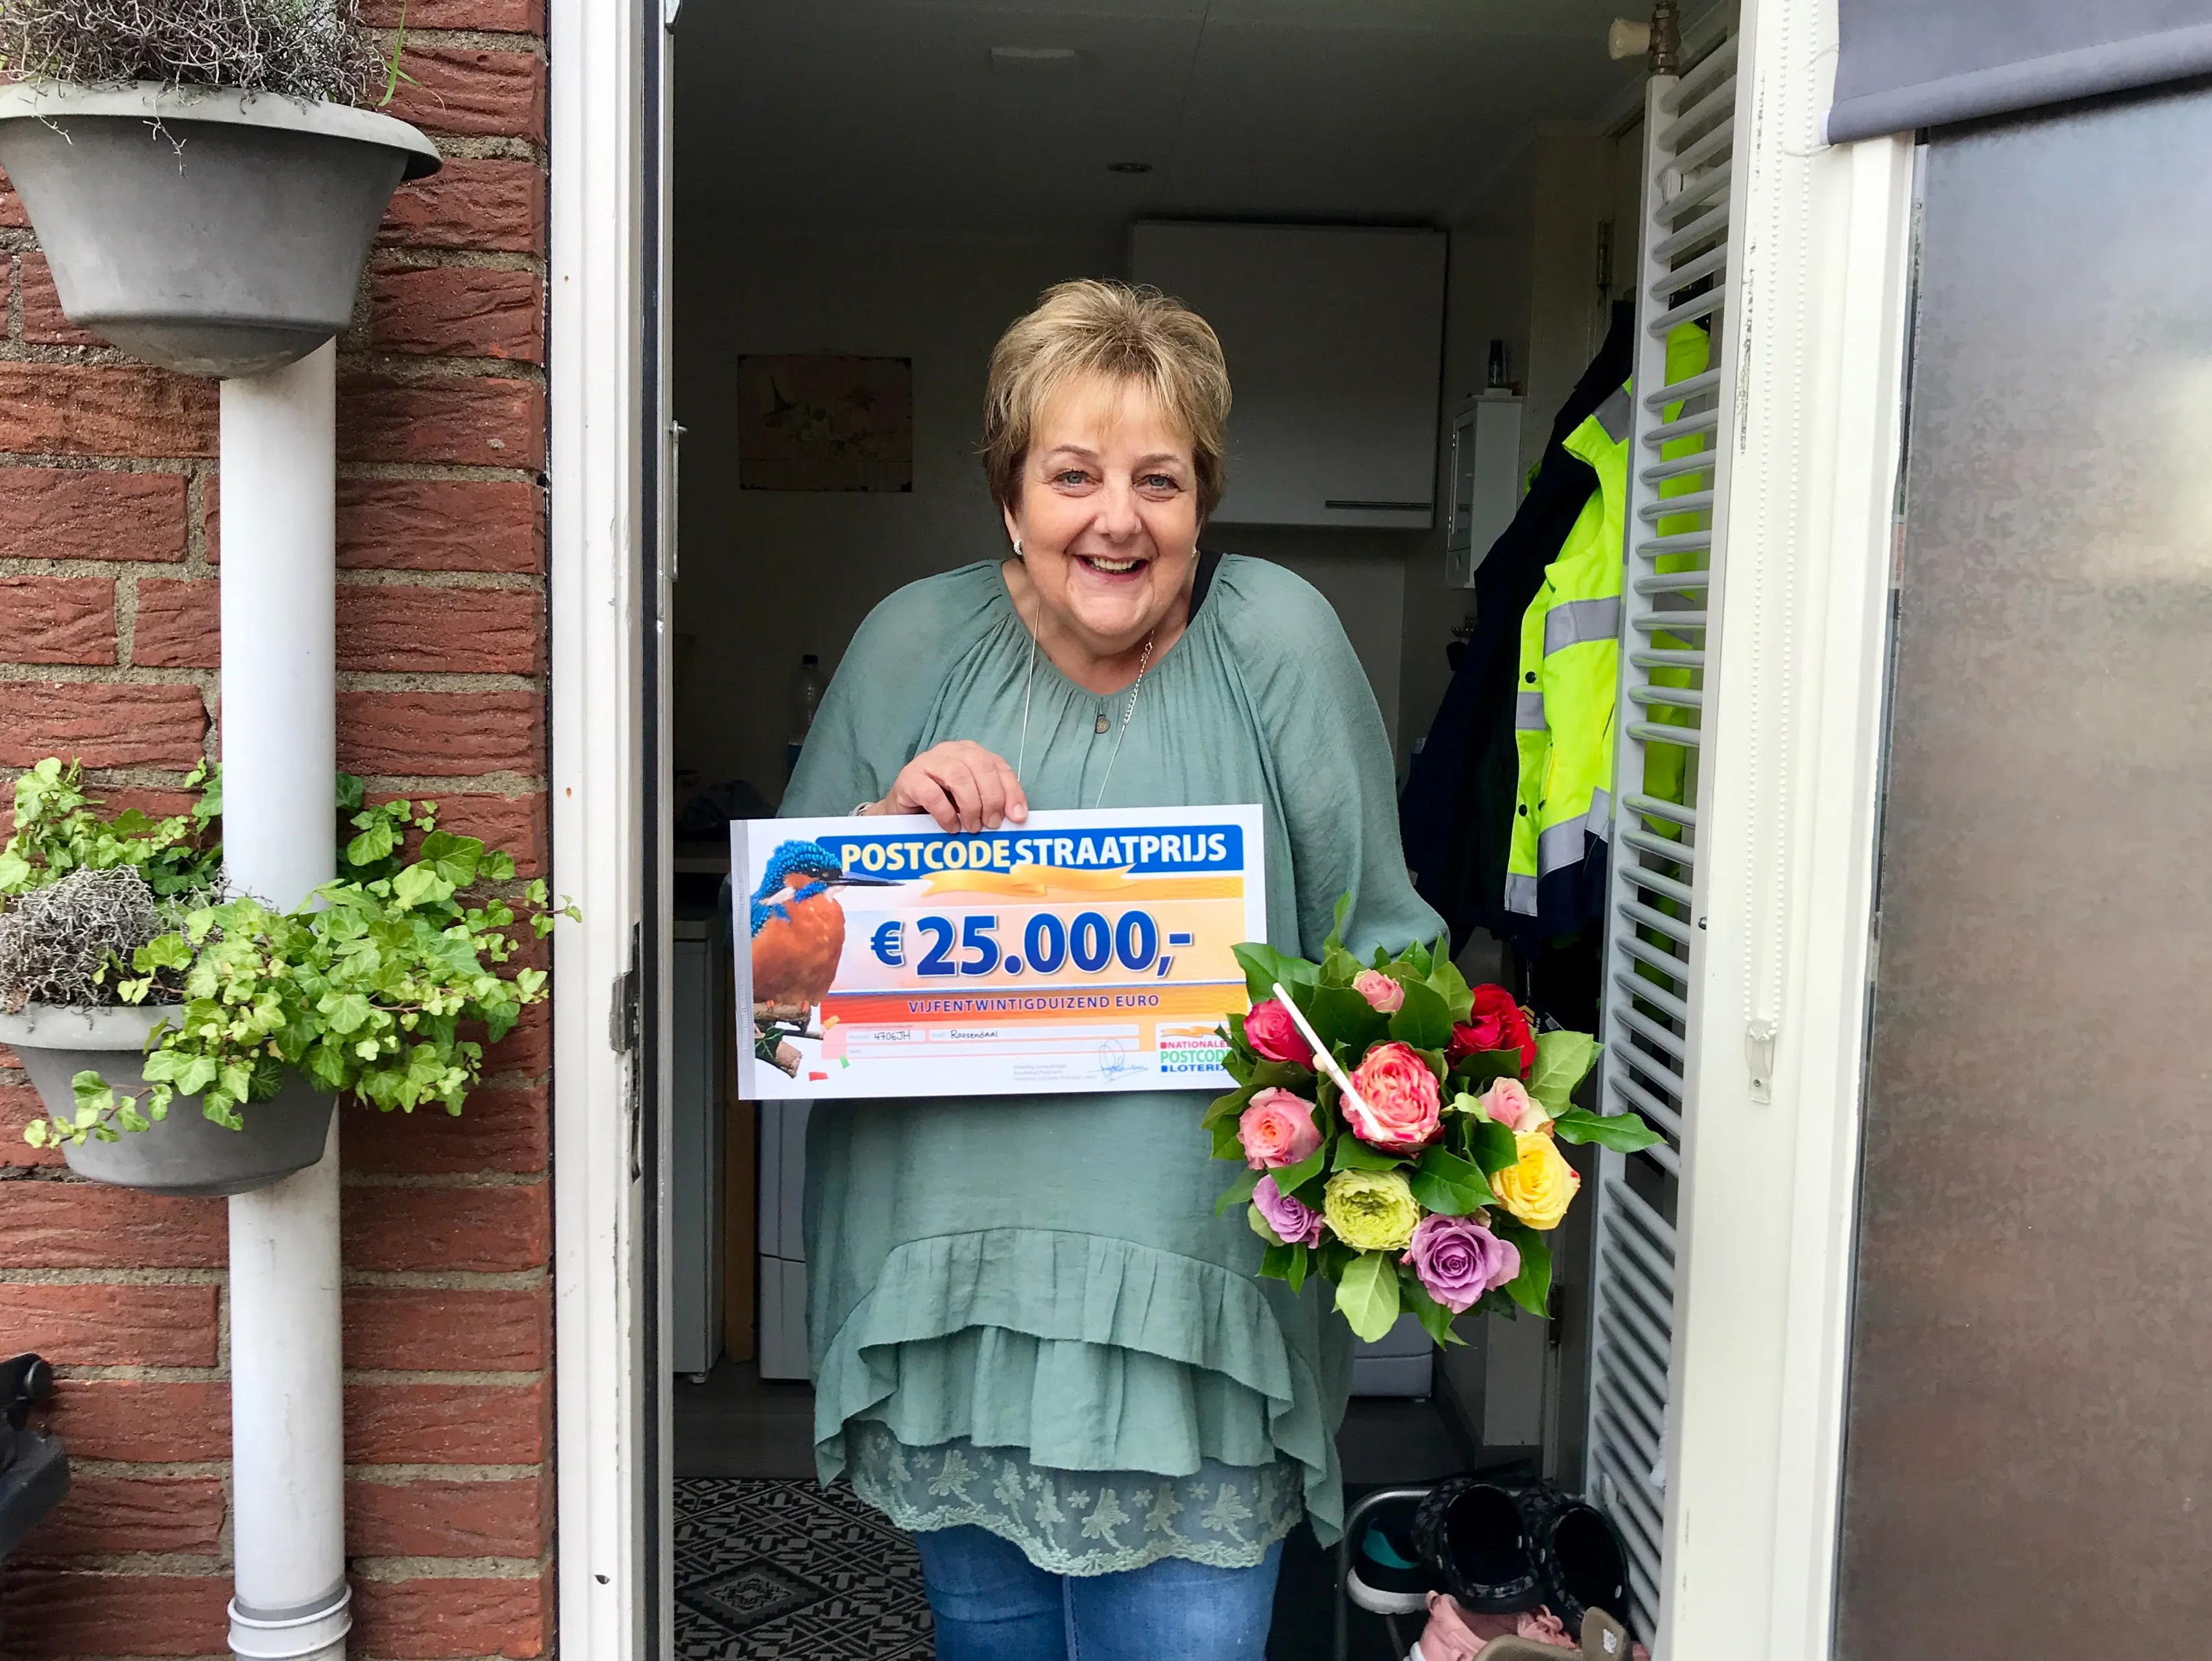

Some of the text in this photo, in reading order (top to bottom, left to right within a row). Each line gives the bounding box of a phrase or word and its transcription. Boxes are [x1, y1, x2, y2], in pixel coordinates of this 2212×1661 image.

[871, 920, 905, 966] €
[908, 994, 1159, 1013] VIJFENTWINTIGDUIZEND EURO
[1160, 1049, 1231, 1063] POSTCOD
